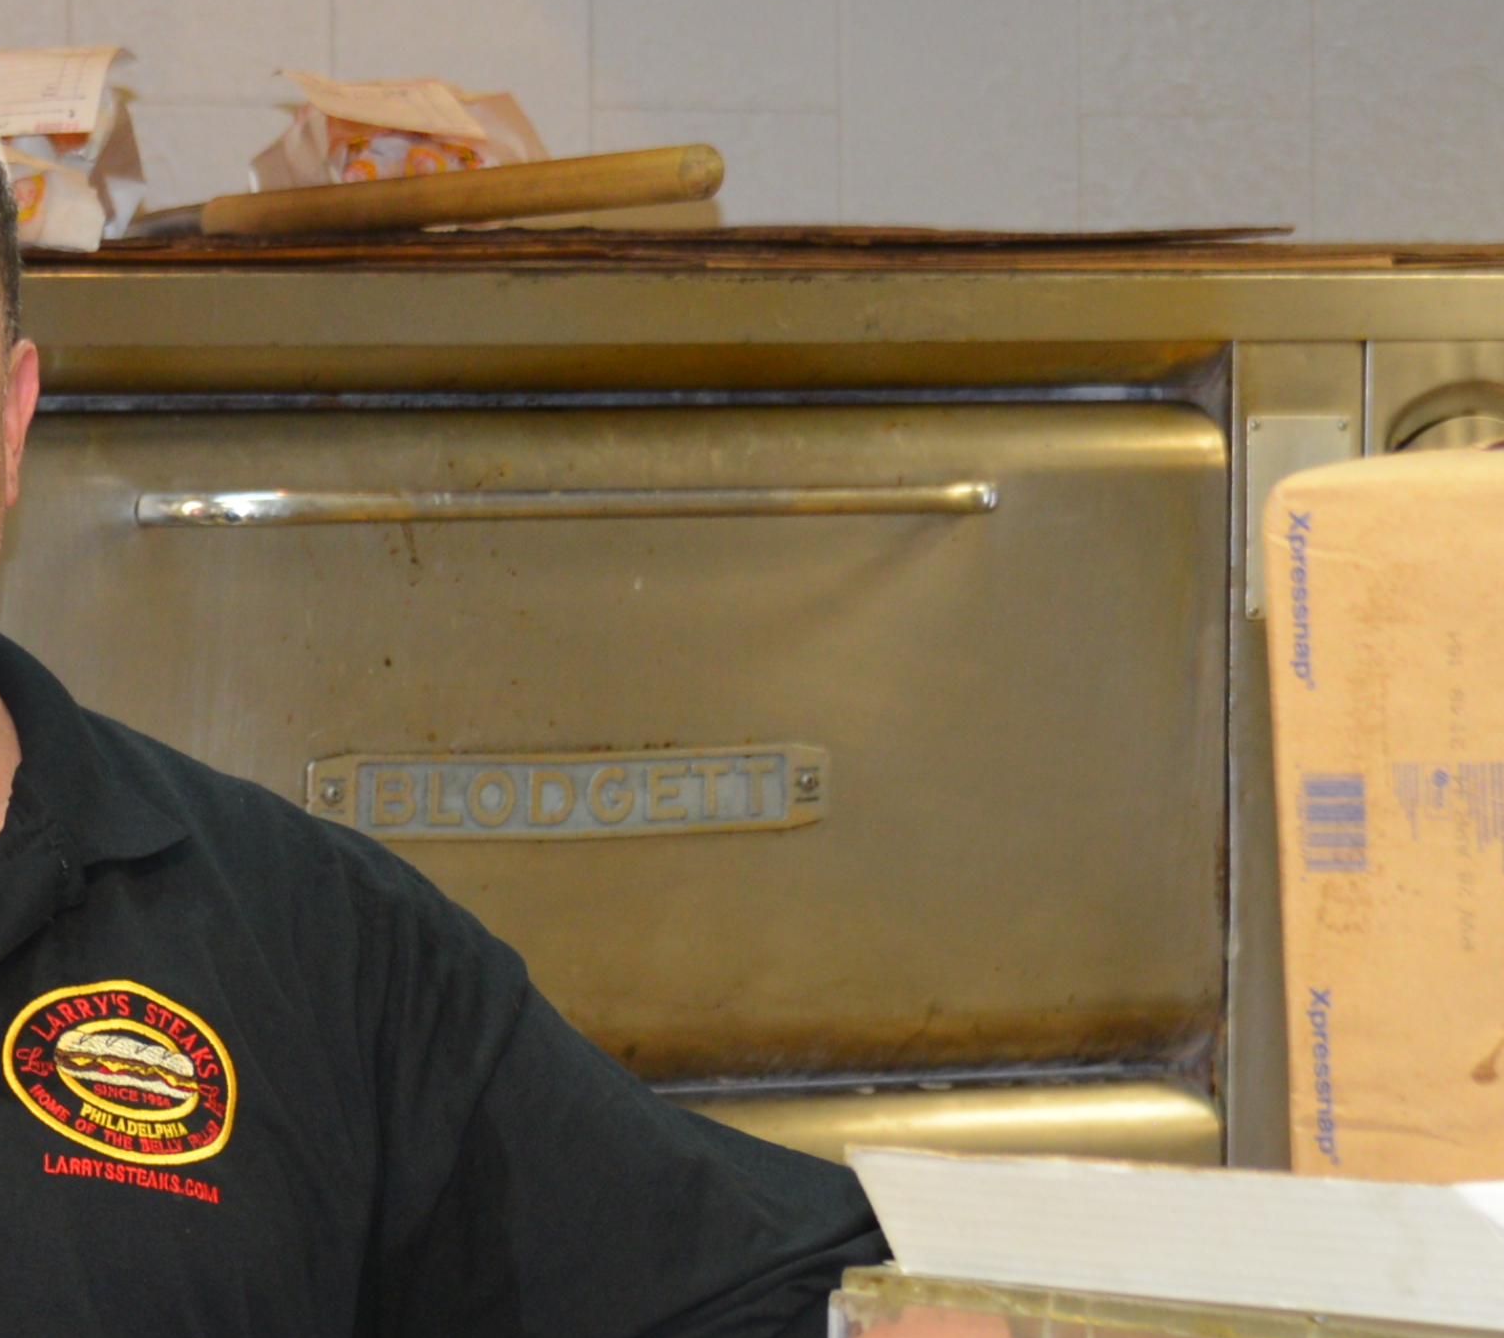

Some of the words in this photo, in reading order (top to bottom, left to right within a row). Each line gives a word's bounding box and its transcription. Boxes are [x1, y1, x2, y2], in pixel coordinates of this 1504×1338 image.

[1285, 511, 1314, 683] Xpressnap
[370, 760, 779, 828] BLODGETT
[30, 993, 132, 1041] LARRY'S
[143, 1003, 220, 1079] STEAKS
[93, 1083, 140, 1102] SINCE
[1307, 987, 1336, 1158] Xpressnap
[29, 1083, 72, 1123] HOME
[75, 1118, 98, 1136] OF
[103, 1128, 134, 1151] THE
[140, 1135, 185, 1154] BELLY
[79, 1102, 188, 1139] PHILADELPHIA
[43, 1153, 220, 1204] LARRYSSTEAKS.COM
